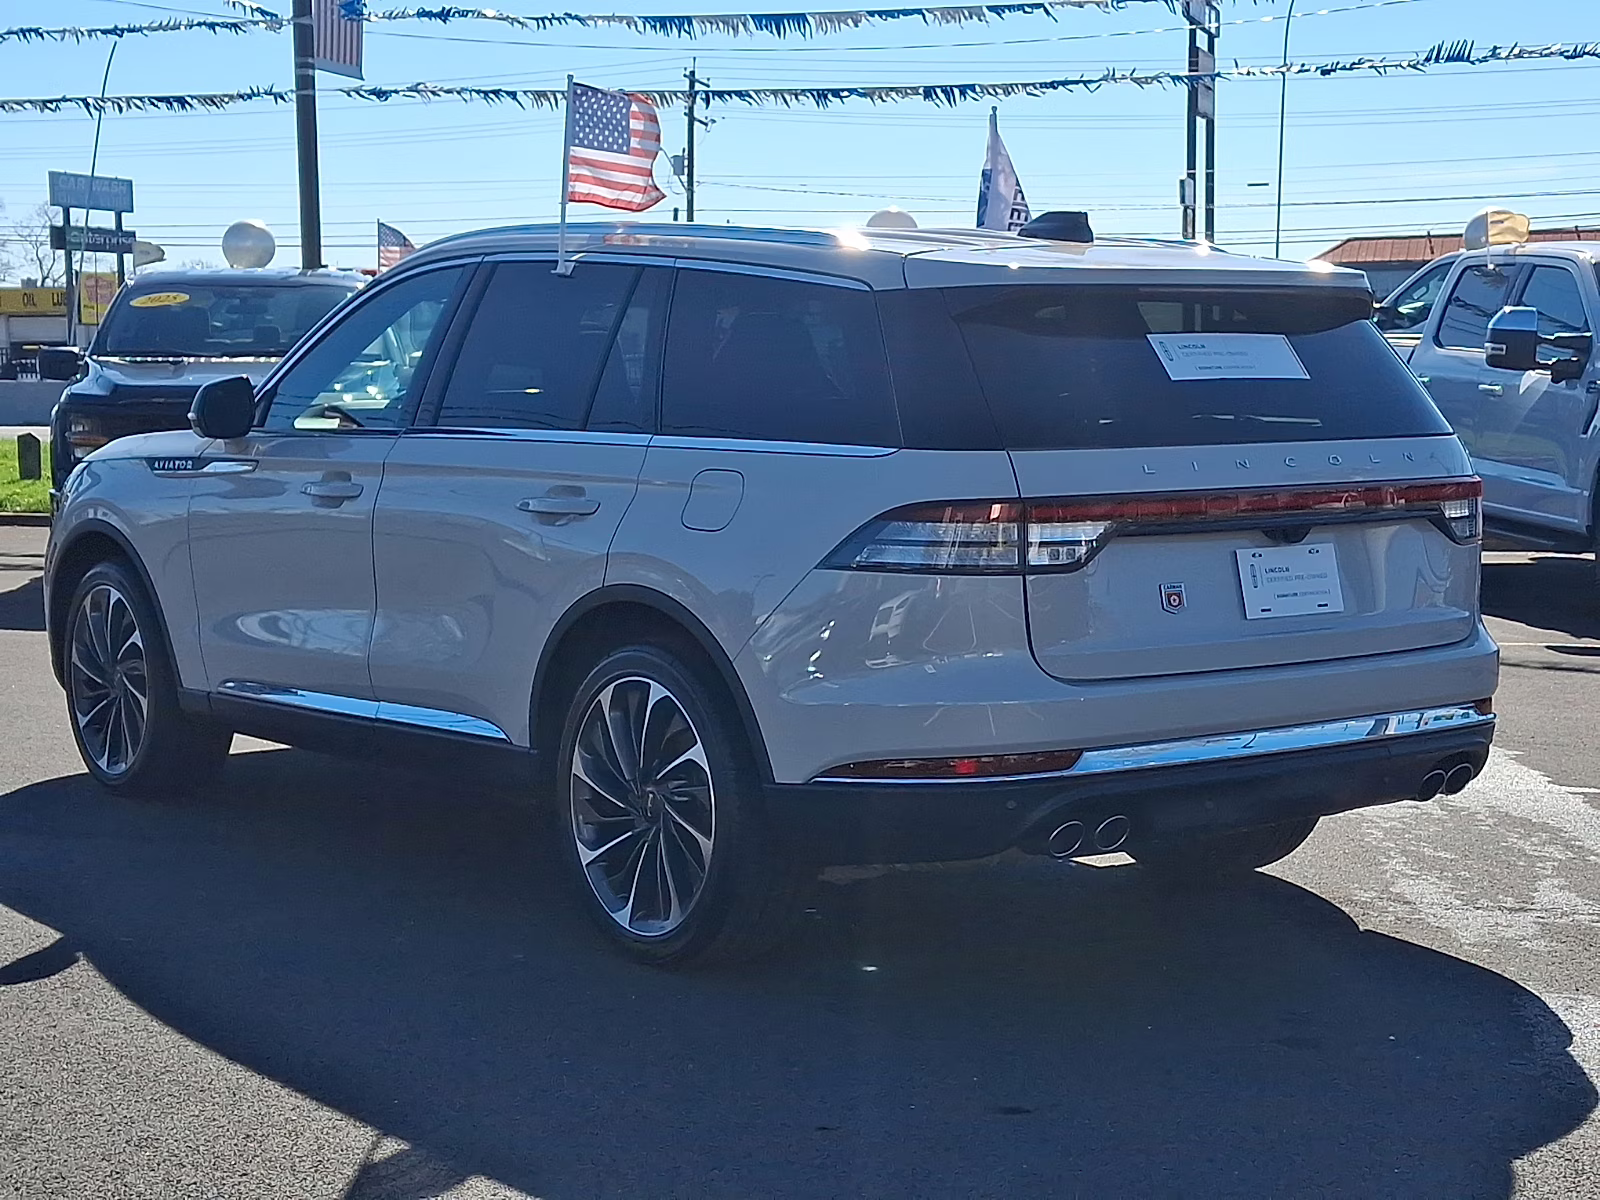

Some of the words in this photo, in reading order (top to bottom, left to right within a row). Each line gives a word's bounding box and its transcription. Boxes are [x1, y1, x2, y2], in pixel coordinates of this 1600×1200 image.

[58, 175, 85, 190] CAR
[92, 179, 127, 194] WASH
[22, 292, 37, 307] OIL
[154, 460, 193, 470] AVIATOR
[1141, 451, 1415, 475] LINCOLN
[1264, 566, 1290, 574] LINCOLN
